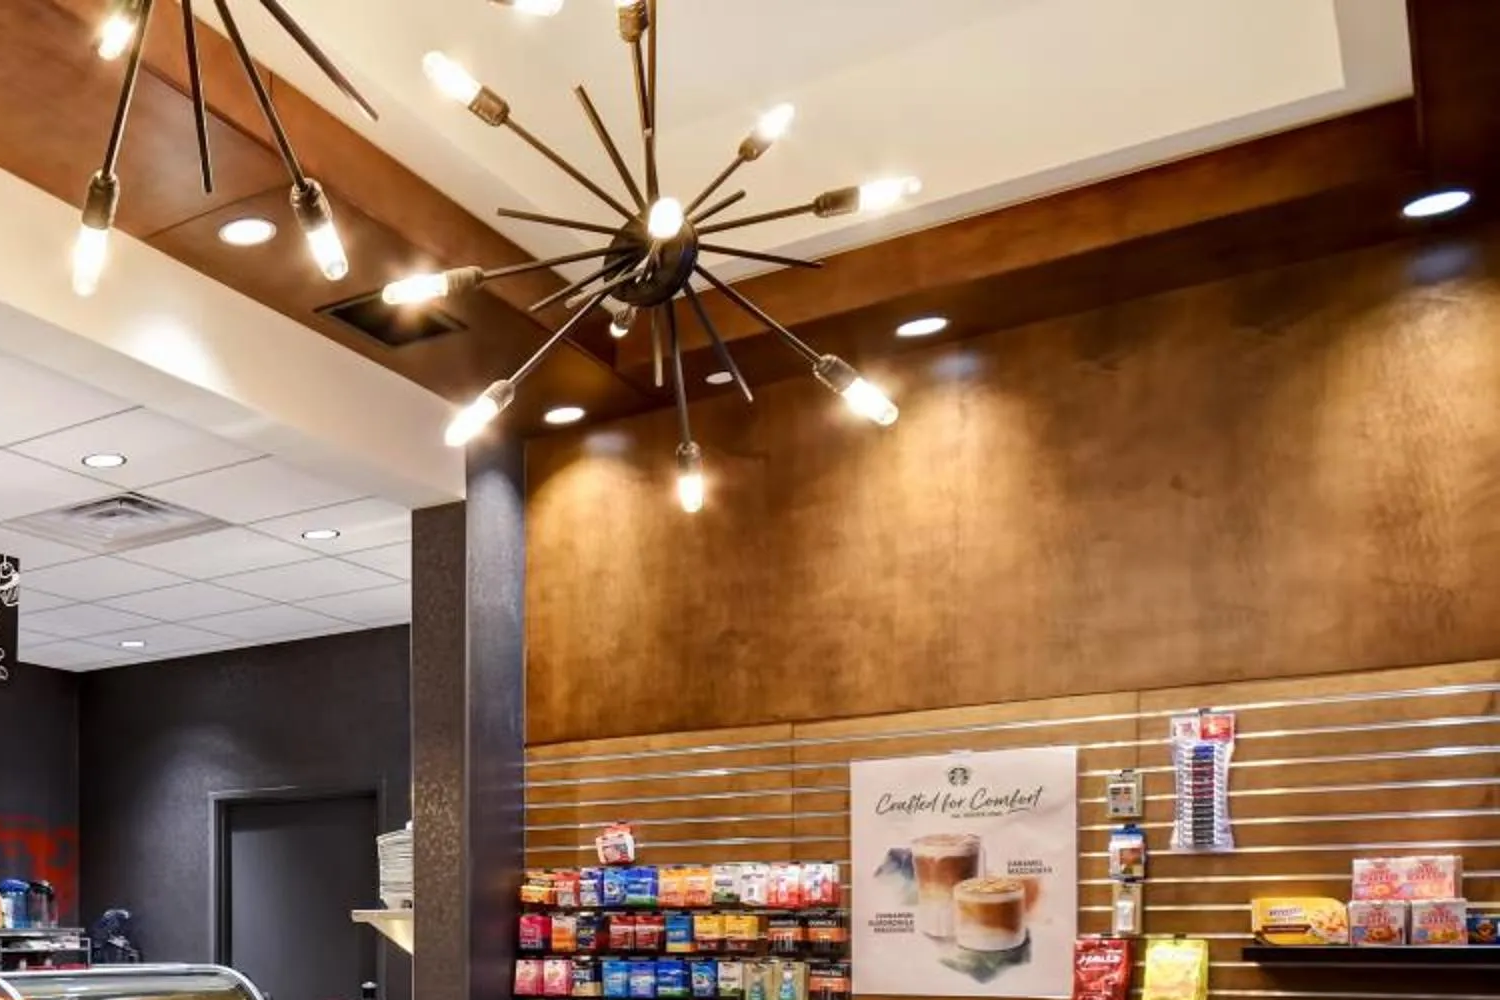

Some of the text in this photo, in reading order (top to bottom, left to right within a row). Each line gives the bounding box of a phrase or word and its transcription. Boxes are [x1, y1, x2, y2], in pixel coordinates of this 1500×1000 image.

[875, 786, 1043, 816] Crafted for Comfort
